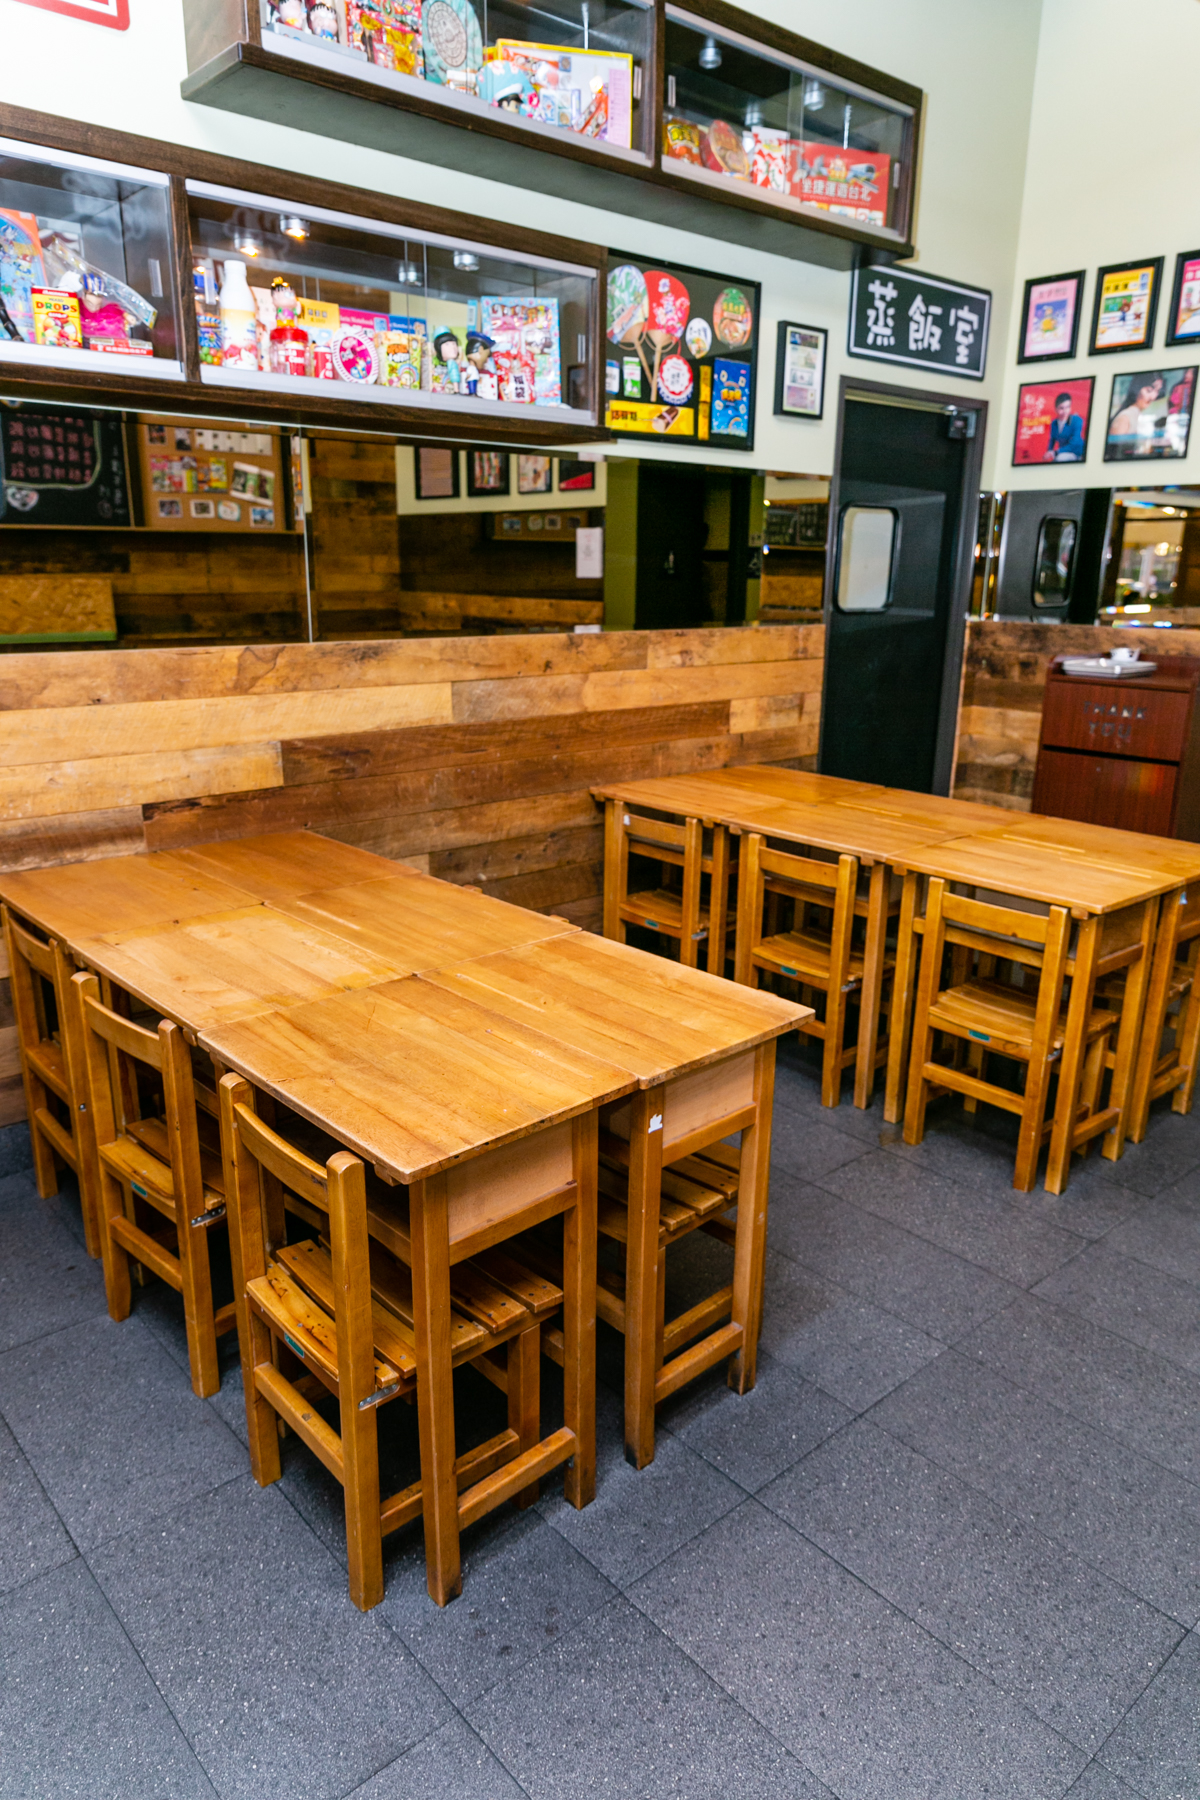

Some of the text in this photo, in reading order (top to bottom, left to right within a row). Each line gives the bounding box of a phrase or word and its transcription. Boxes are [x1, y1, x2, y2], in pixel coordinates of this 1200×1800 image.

[35, 301, 78, 313] DROPS
[867, 279, 979, 364] 蒸飯室
[1083, 701, 1147, 719] THANK
[1089, 721, 1132, 738] YOU
